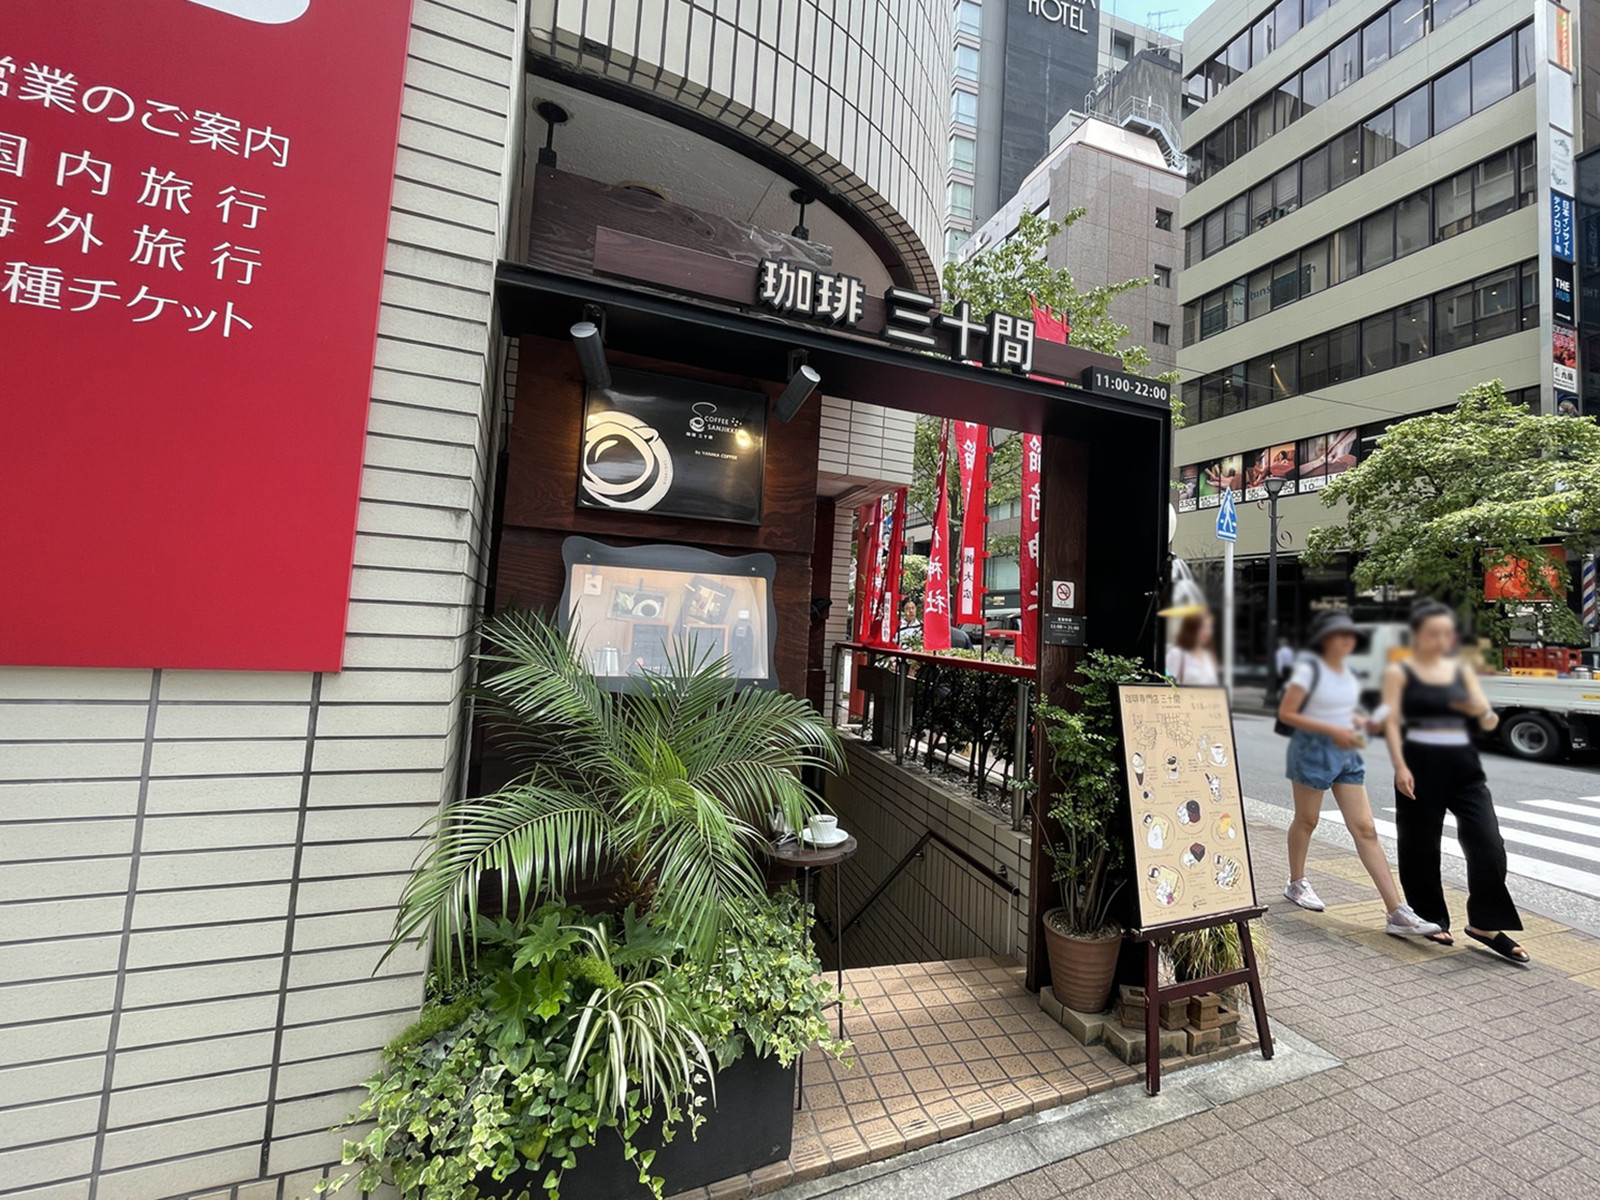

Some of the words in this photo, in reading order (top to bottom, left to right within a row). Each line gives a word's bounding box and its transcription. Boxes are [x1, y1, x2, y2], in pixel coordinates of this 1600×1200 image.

[1028, 0, 1089, 34] HOTEL
[1555, 277, 1571, 292] THE
[1, 260, 254, 339] 種チケット
[762, 260, 863, 324] 珈琲
[885, 287, 1036, 373] 三十間
[1095, 373, 1168, 401] 11:00-22:00
[704, 415, 729, 425] COFFEE
[707, 424, 742, 434] SANJIKKE
